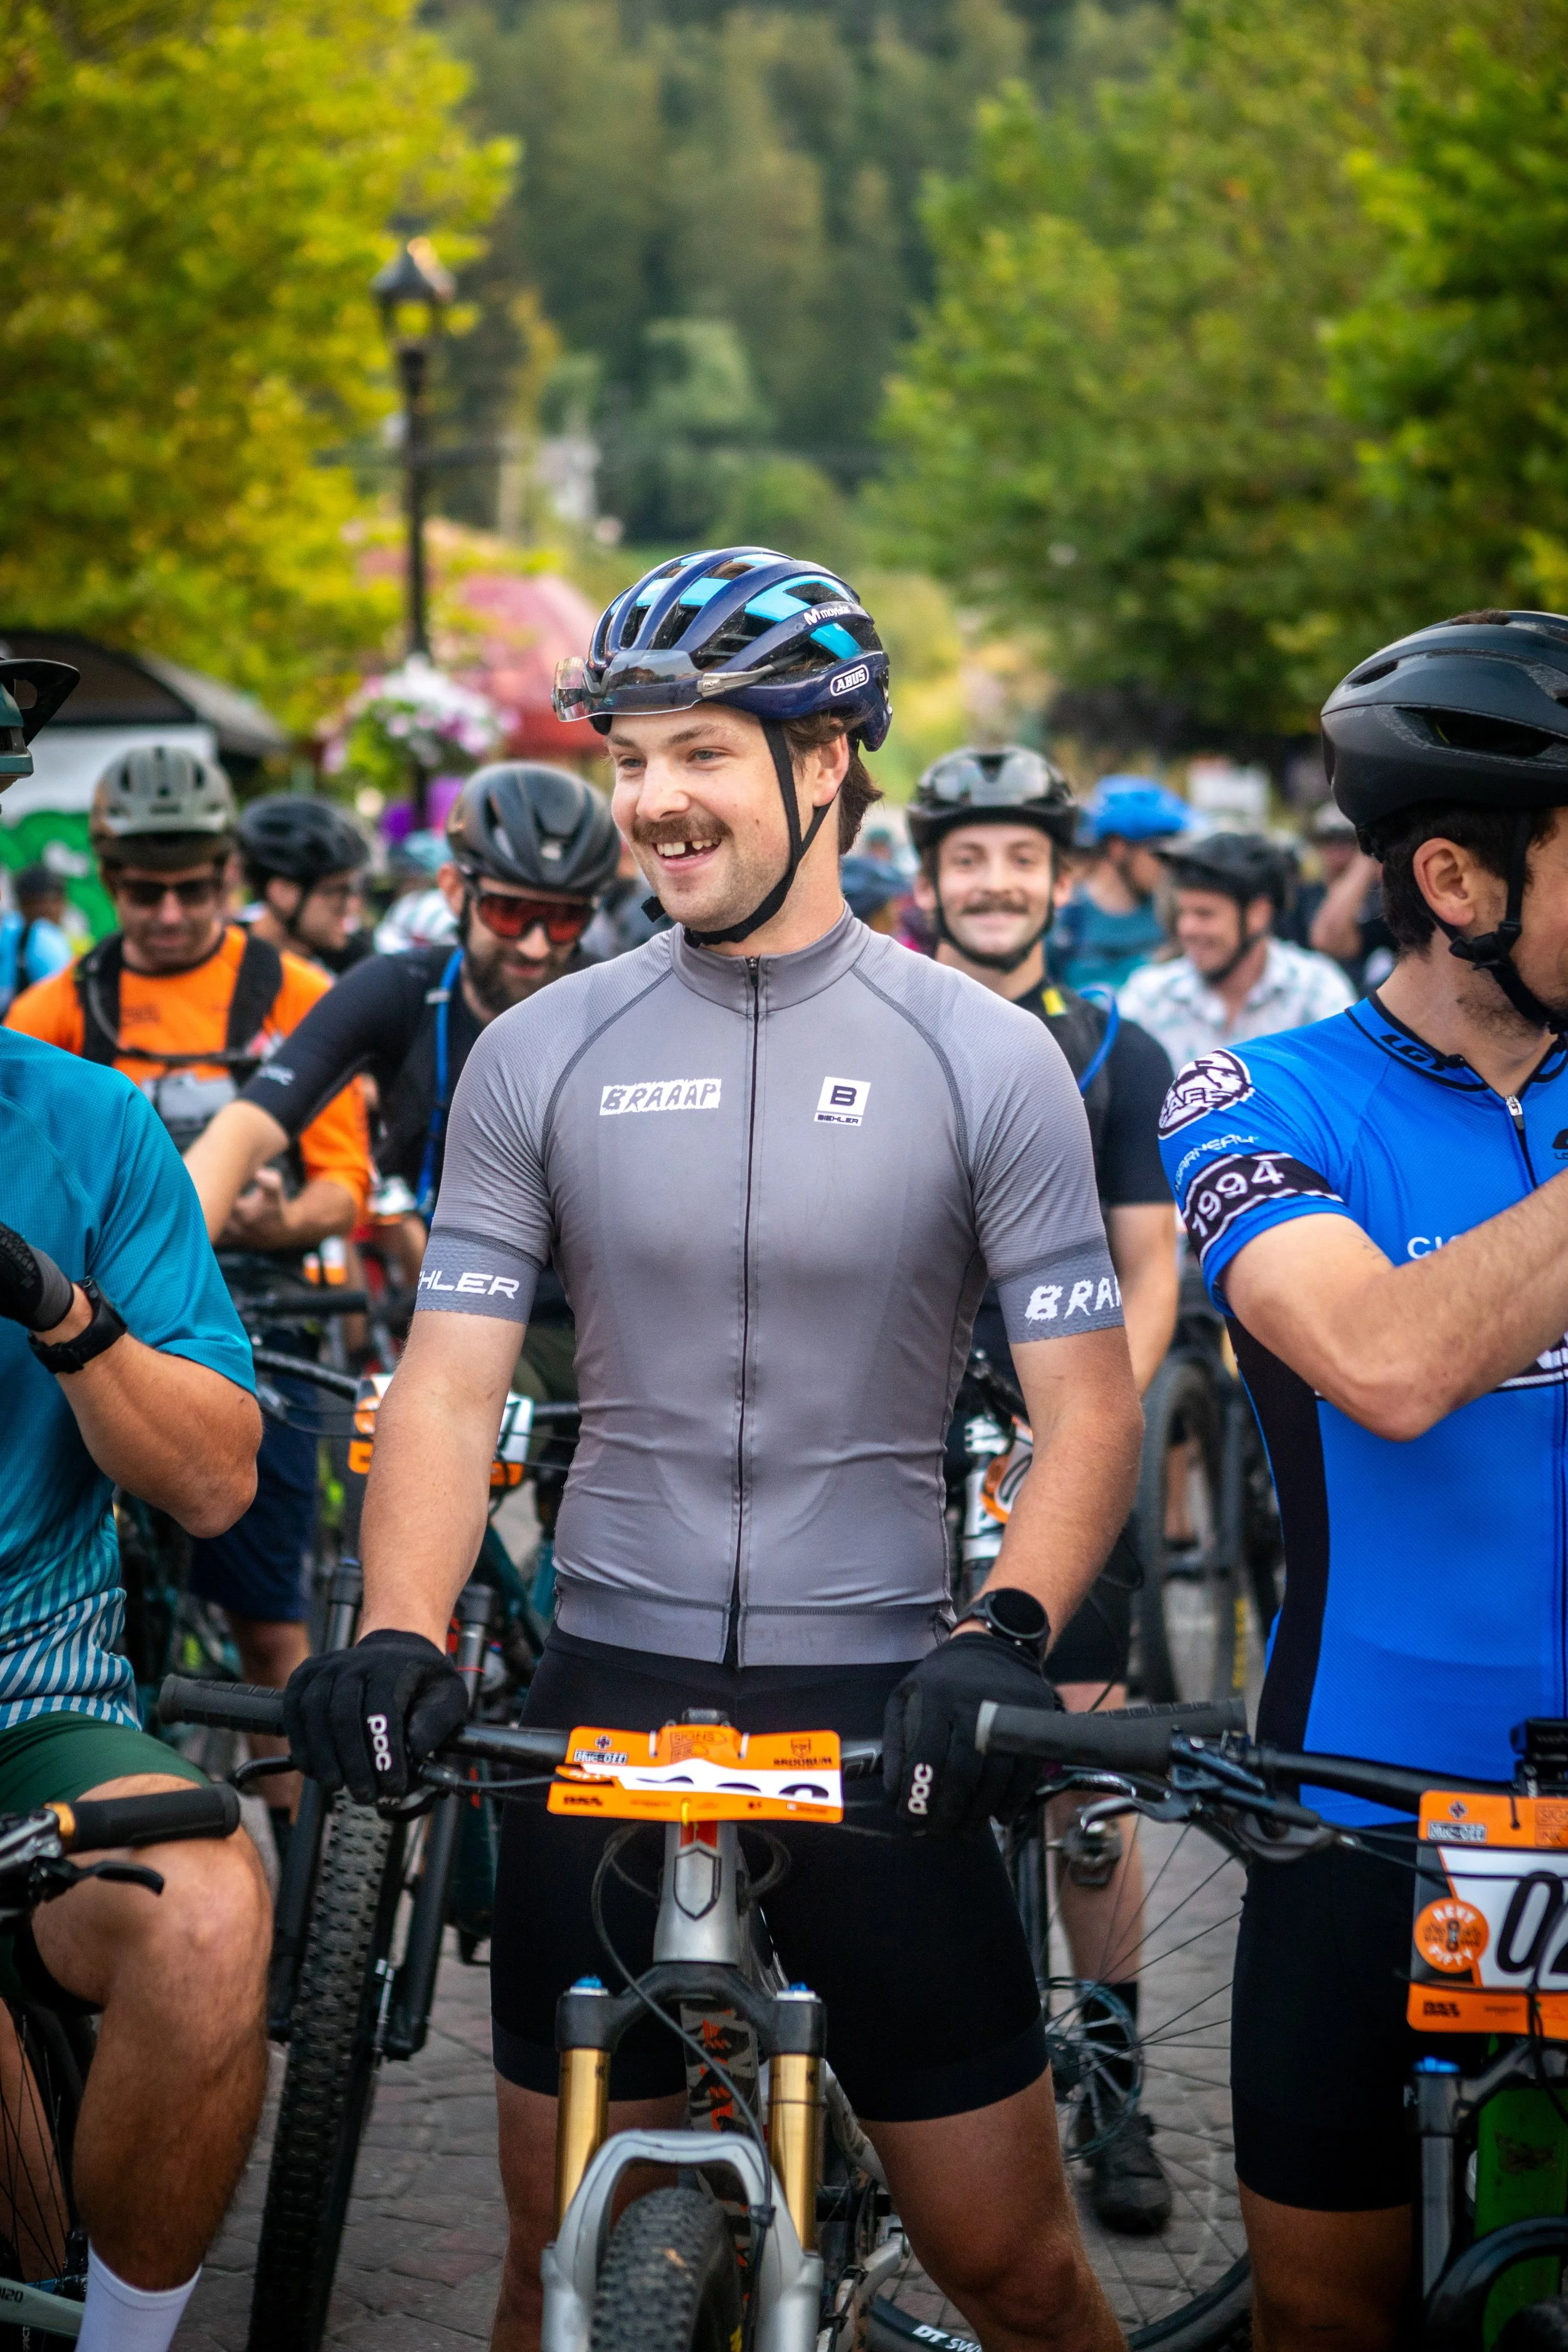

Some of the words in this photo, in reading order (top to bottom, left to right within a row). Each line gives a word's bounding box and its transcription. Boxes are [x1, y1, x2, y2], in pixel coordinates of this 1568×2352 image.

[836, 668, 866, 692] ABUS
[601, 1083, 717, 1111] BRAAAP
[830, 1085, 857, 1106] B
[817, 1114, 859, 1124] BIEHLER
[1192, 1160, 1285, 1237] 1994
[418, 1270, 519, 1300] HLER
[1496, 1871, 1568, 1974] 0
[912, 2324, 951, 2343] DT
